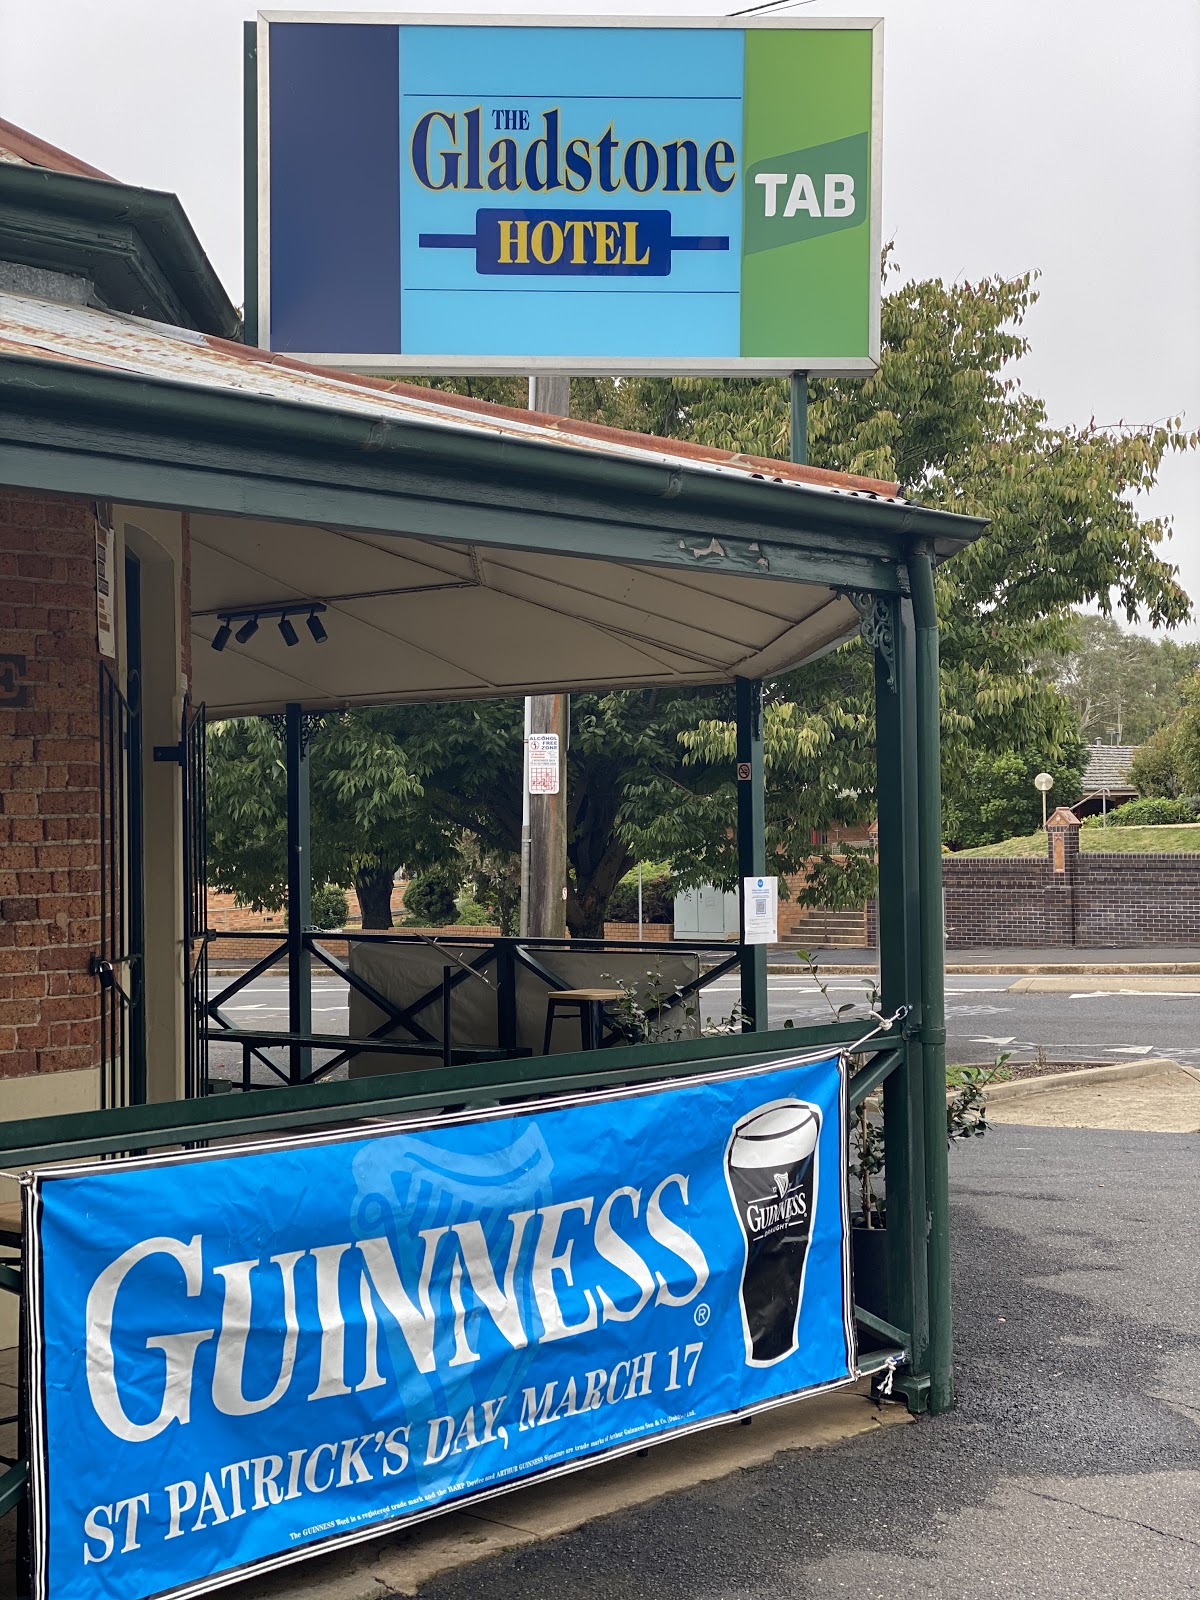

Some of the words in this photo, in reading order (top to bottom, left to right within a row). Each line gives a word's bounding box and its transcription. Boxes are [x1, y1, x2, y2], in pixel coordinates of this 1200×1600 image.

[491, 108, 530, 131] THE
[410, 105, 737, 195] Gladstone
[755, 173, 856, 218] TAB
[497, 219, 651, 266] HOTEL
[747, 1193, 806, 1232] GUINNESS
[763, 1222, 789, 1237] DRAUGHT
[85, 1173, 711, 1444] GUINNESS
[83, 1493, 150, 1565] ST
[164, 1425, 411, 1540] PATRICK'S
[423, 1396, 508, 1467] DAY,
[519, 1353, 657, 1432] MARCH
[665, 1342, 704, 1392] 17
[289, 1532, 301, 1541] The
[303, 1521, 335, 1536] GUINNESS
[335, 1517, 349, 1527] Word
[362, 1506, 390, 1518] registered
[391, 1500, 407, 1511] trade
[408, 1495, 423, 1505] mark
[424, 1491, 436, 1501] and
[437, 1488, 447, 1497] the
[448, 1482, 465, 1493] HARP
[466, 1477, 484, 1487] Device
[485, 1473, 495, 1482] and
[496, 1466, 518, 1477] ARTHUR
[519, 1457, 543, 1471] GUINNESS
[575, 1443, 590, 1452] trade
[591, 1439, 604, 1448] marks
[645, 1422, 654, 1430] Son
